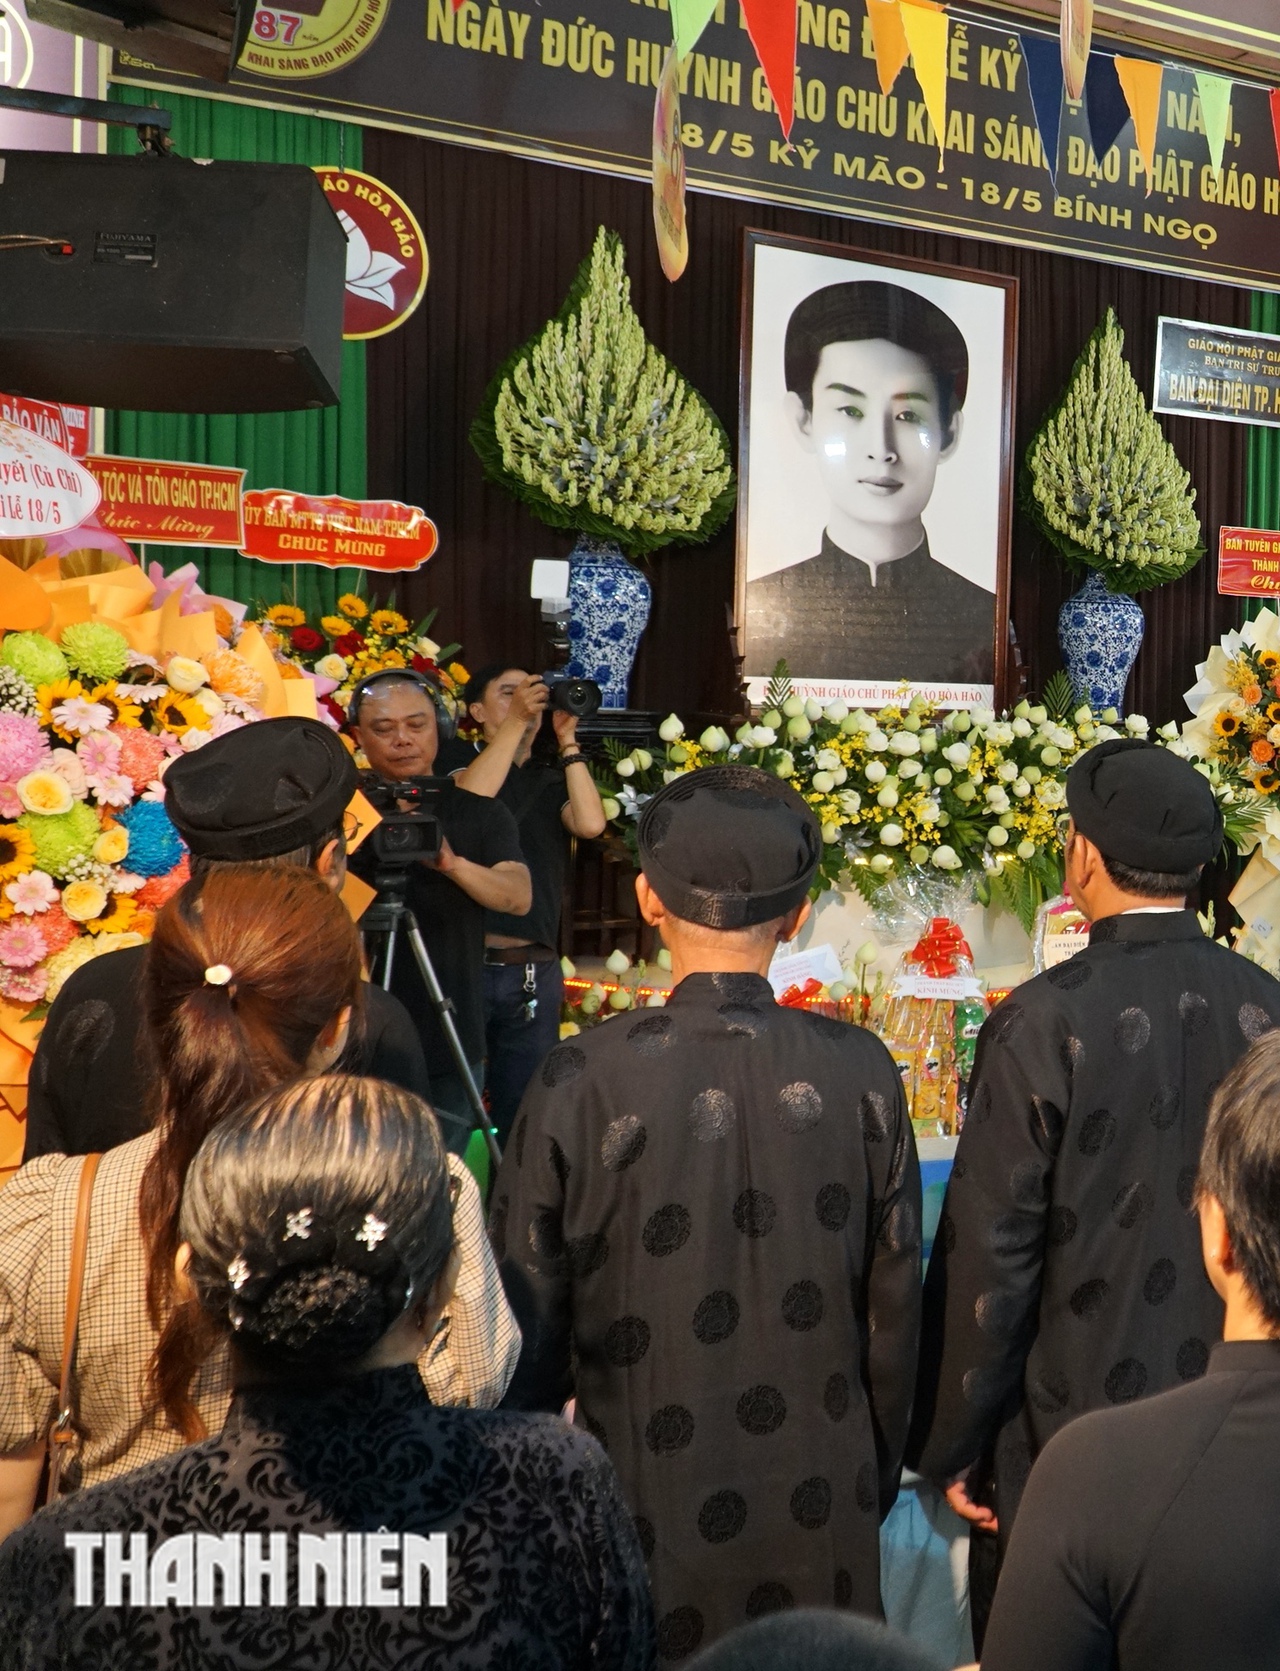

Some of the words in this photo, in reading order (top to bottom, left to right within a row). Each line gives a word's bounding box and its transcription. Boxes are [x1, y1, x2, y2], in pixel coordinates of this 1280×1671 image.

[247, 51, 275, 69] KHAI
[277, 56, 310, 71] SÁNG
[310, 51, 335, 68] ĐẠO
[333, 35, 360, 59] PHẬT
[355, 13, 376, 38] GIÁO
[254, 10, 302, 45] 87
[980, 38, 1021, 92] KỶ
[426, 0, 532, 60] NGÀY
[541, 16, 615, 78] ĐỨC
[907, 99, 975, 155] KAI
[1067, 136, 1120, 188] ĐẠO
[1129, 150, 1193, 203] PHẬT
[1200, 159, 1256, 211] GIÁO
[769, 138, 821, 171] KỶ
[833, 153, 926, 191] MÃO
[961, 177, 1042, 214] 18/5
[1053, 191, 1132, 231] BÍNH
[1143, 214, 1218, 250] NGỌ
[354, 183, 392, 218] HÒA
[390, 217, 415, 258] HẢO
[1188, 337, 1213, 351] GIÁO
[1216, 340, 1235, 357] HỘI
[1237, 345, 1264, 361] PHẬT
[1228, 359, 1244, 371] TRỊ
[1246, 361, 1260, 375] SỰ
[1169, 373, 1195, 402] BAN
[1198, 376, 1219, 411] ĐẠI
[1222, 376, 1250, 415] DIỆN
[1254, 385, 1271, 413] TP.
[33, 410, 61, 443] VÂN
[30, 463, 55, 489] (Củ
[57, 468, 83, 498] Chi)
[103, 468, 125, 509] TỘC
[128, 466, 142, 504] VÀ
[146, 468, 169, 507] TÔN
[171, 471, 197, 510] GIÁO
[199, 480, 236, 511] TP.HCM
[28, 499, 61, 525] 18/5
[147, 516, 215, 539] Mừng
[264, 508, 286, 528] BAN
[355, 517, 381, 535] NAM
[278, 533, 329, 552] CHÚC
[334, 538, 386, 557] MỪNG
[1225, 538, 1242, 550] BAN
[1244, 540, 1270, 553] TUYÊN
[1252, 557, 1279, 573] THÀNH
[828, 684, 856, 699] GIÁO
[857, 684, 880, 699] CHỦ
[938, 687, 959, 701] HÒA
[961, 687, 982, 702] HẢO
